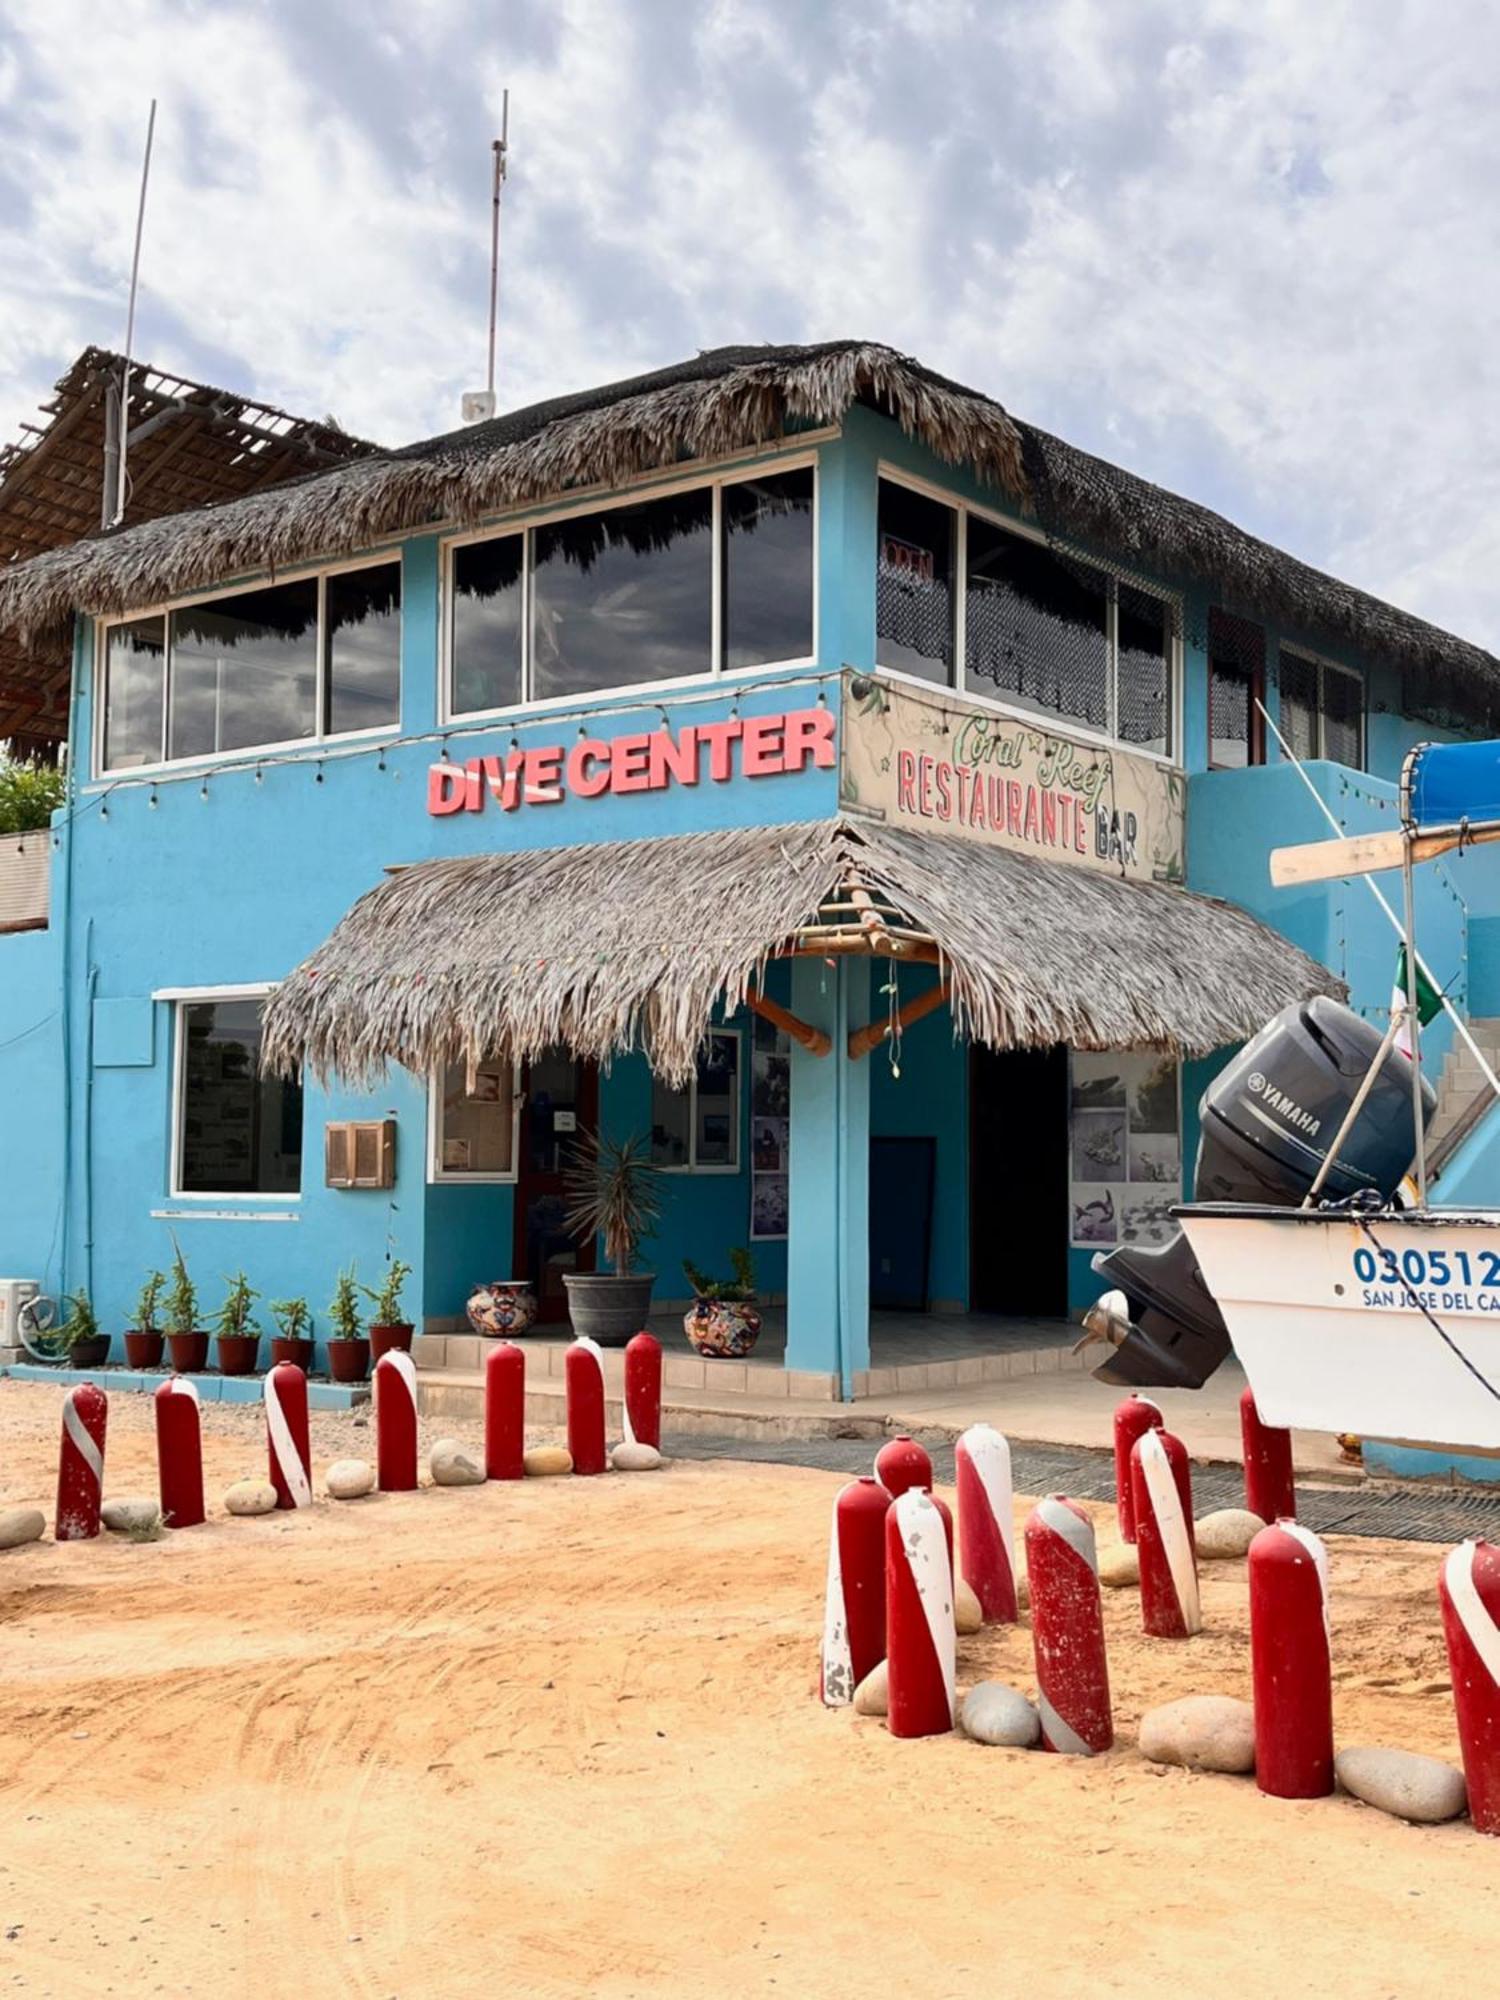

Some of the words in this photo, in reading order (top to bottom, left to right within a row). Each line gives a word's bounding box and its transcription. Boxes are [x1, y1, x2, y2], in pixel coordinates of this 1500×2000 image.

[427, 746, 565, 816] DIVE
[566, 708, 837, 798] CENTER
[953, 709, 1025, 768] Coral
[1038, 739, 1113, 815] Reef
[898, 749, 1088, 854] RESTAURANTE
[1095, 802, 1138, 866] BAR
[1261, 1083, 1321, 1137] YAMAHA
[1353, 1247, 1500, 1287] 030512
[1363, 1289, 1395, 1306] SAN
[1400, 1291, 1438, 1308] JOSE
[1442, 1293, 1473, 1310] DEL
